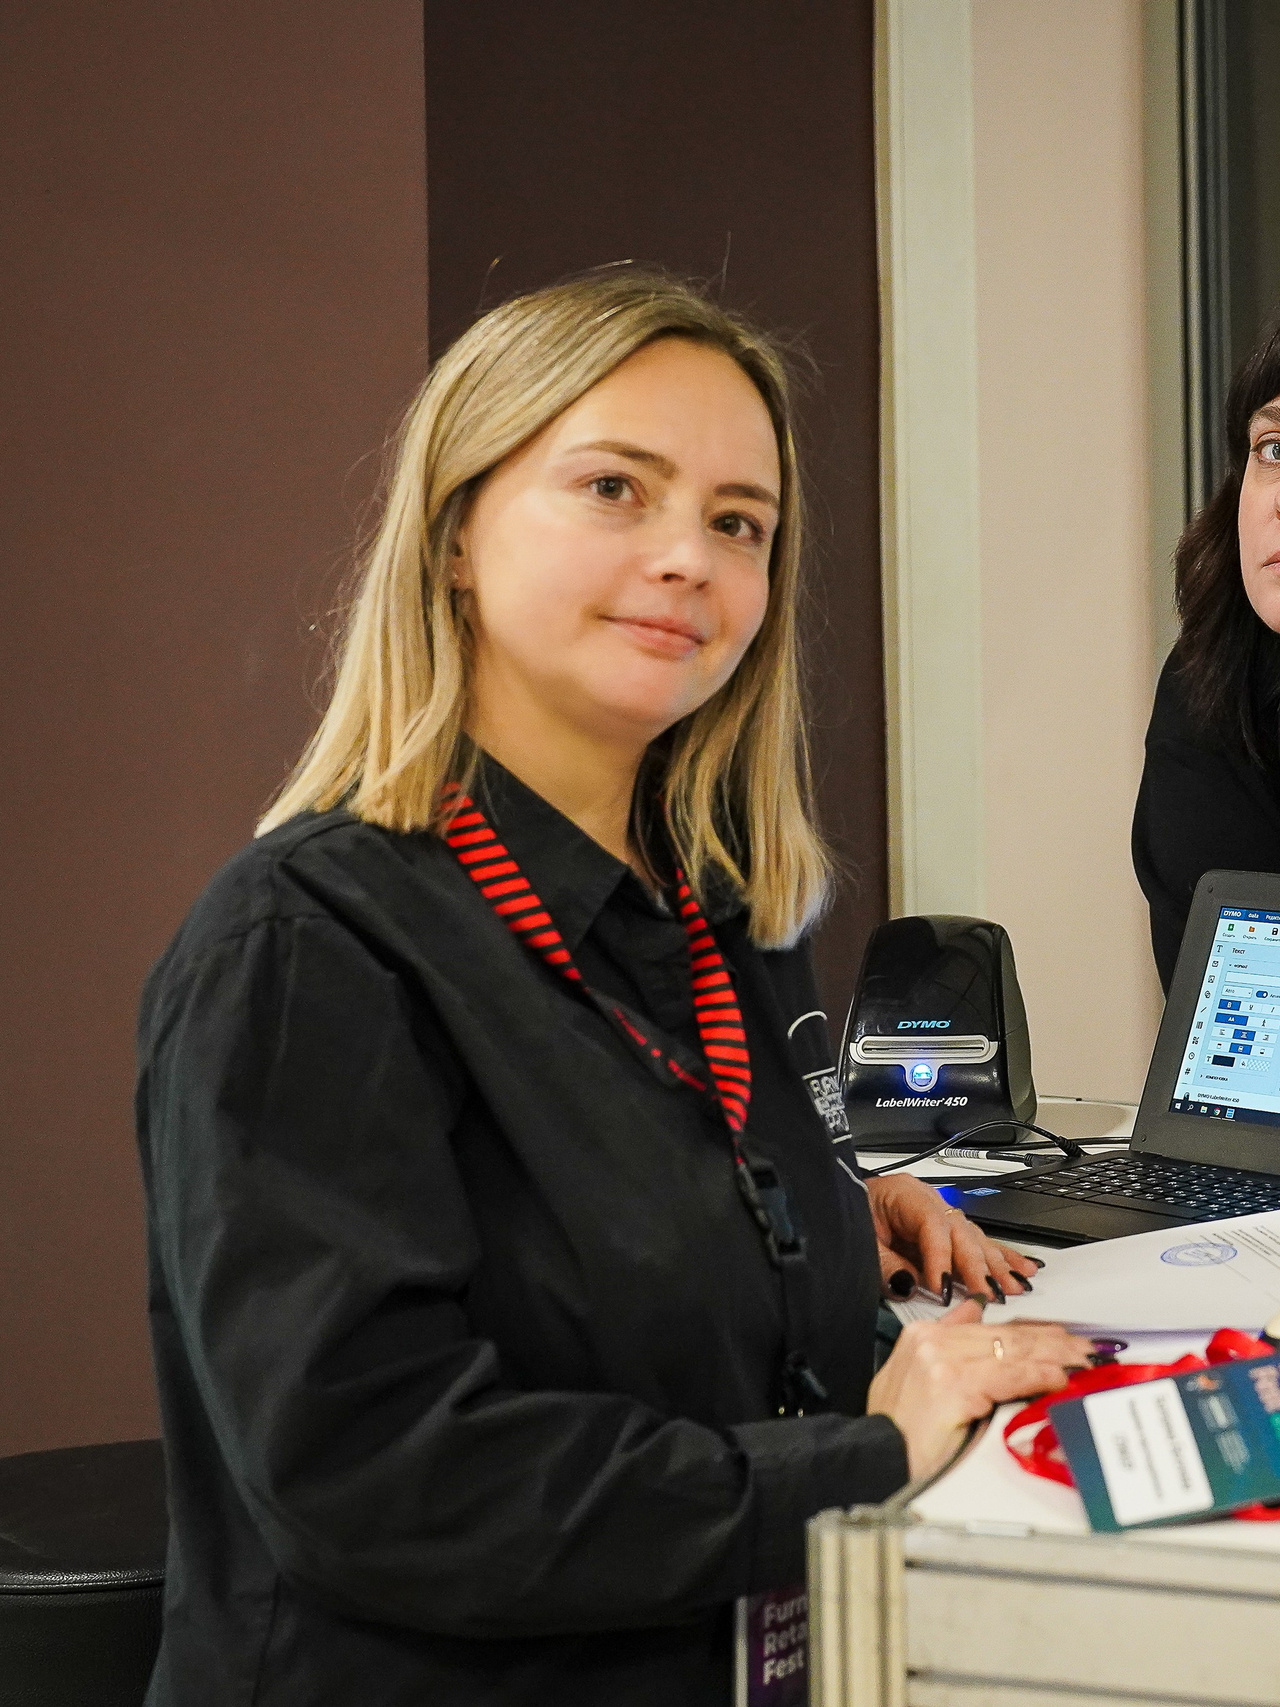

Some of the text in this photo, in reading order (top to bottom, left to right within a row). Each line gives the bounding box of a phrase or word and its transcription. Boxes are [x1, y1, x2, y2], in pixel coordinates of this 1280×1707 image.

[1232, 947, 1246, 955] Текст
[897, 1020, 951, 1029] DYMO
[876, 1097, 968, 1107] LabelWriter 450
